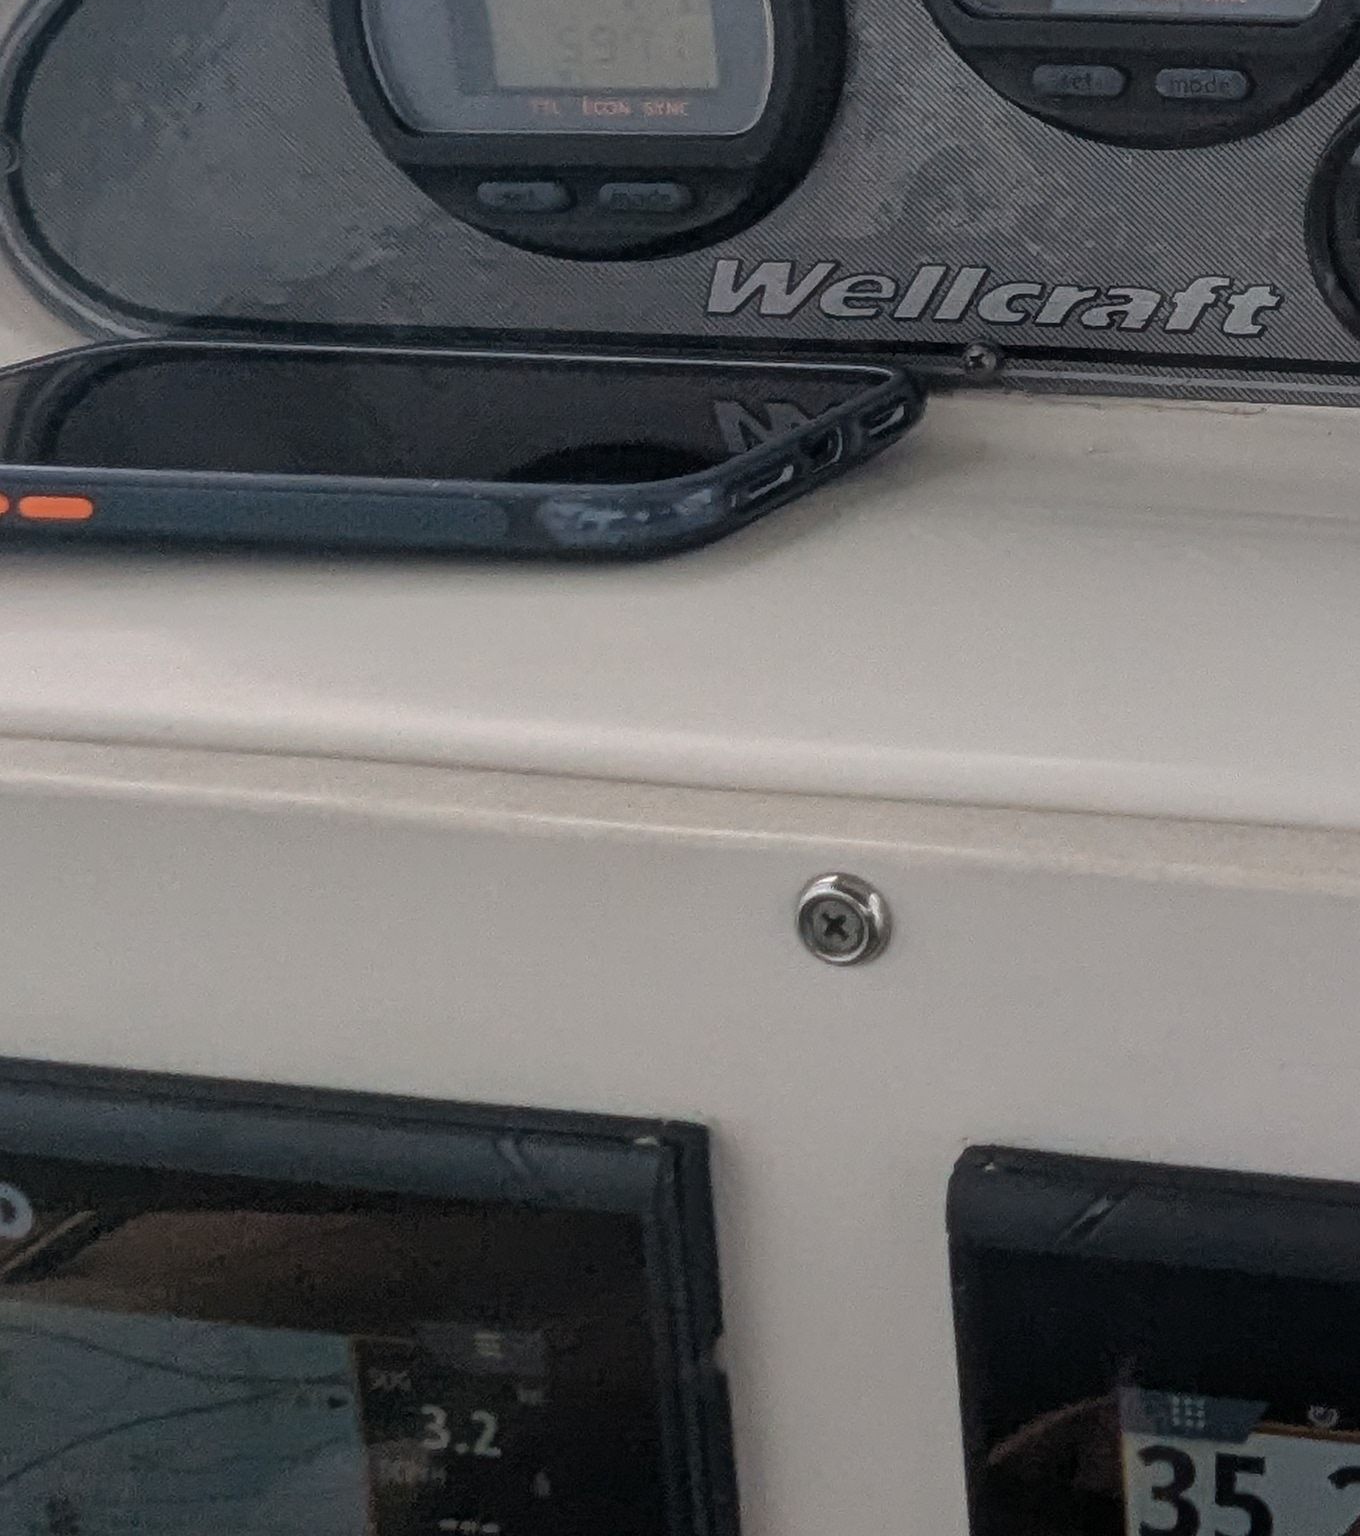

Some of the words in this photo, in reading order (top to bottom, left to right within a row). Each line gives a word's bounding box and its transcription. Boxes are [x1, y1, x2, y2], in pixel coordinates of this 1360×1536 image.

[1169, 74, 1231, 94] mode
[706, 257, 1284, 337] Wellcraft
[420, 1404, 502, 1458] 3.2
